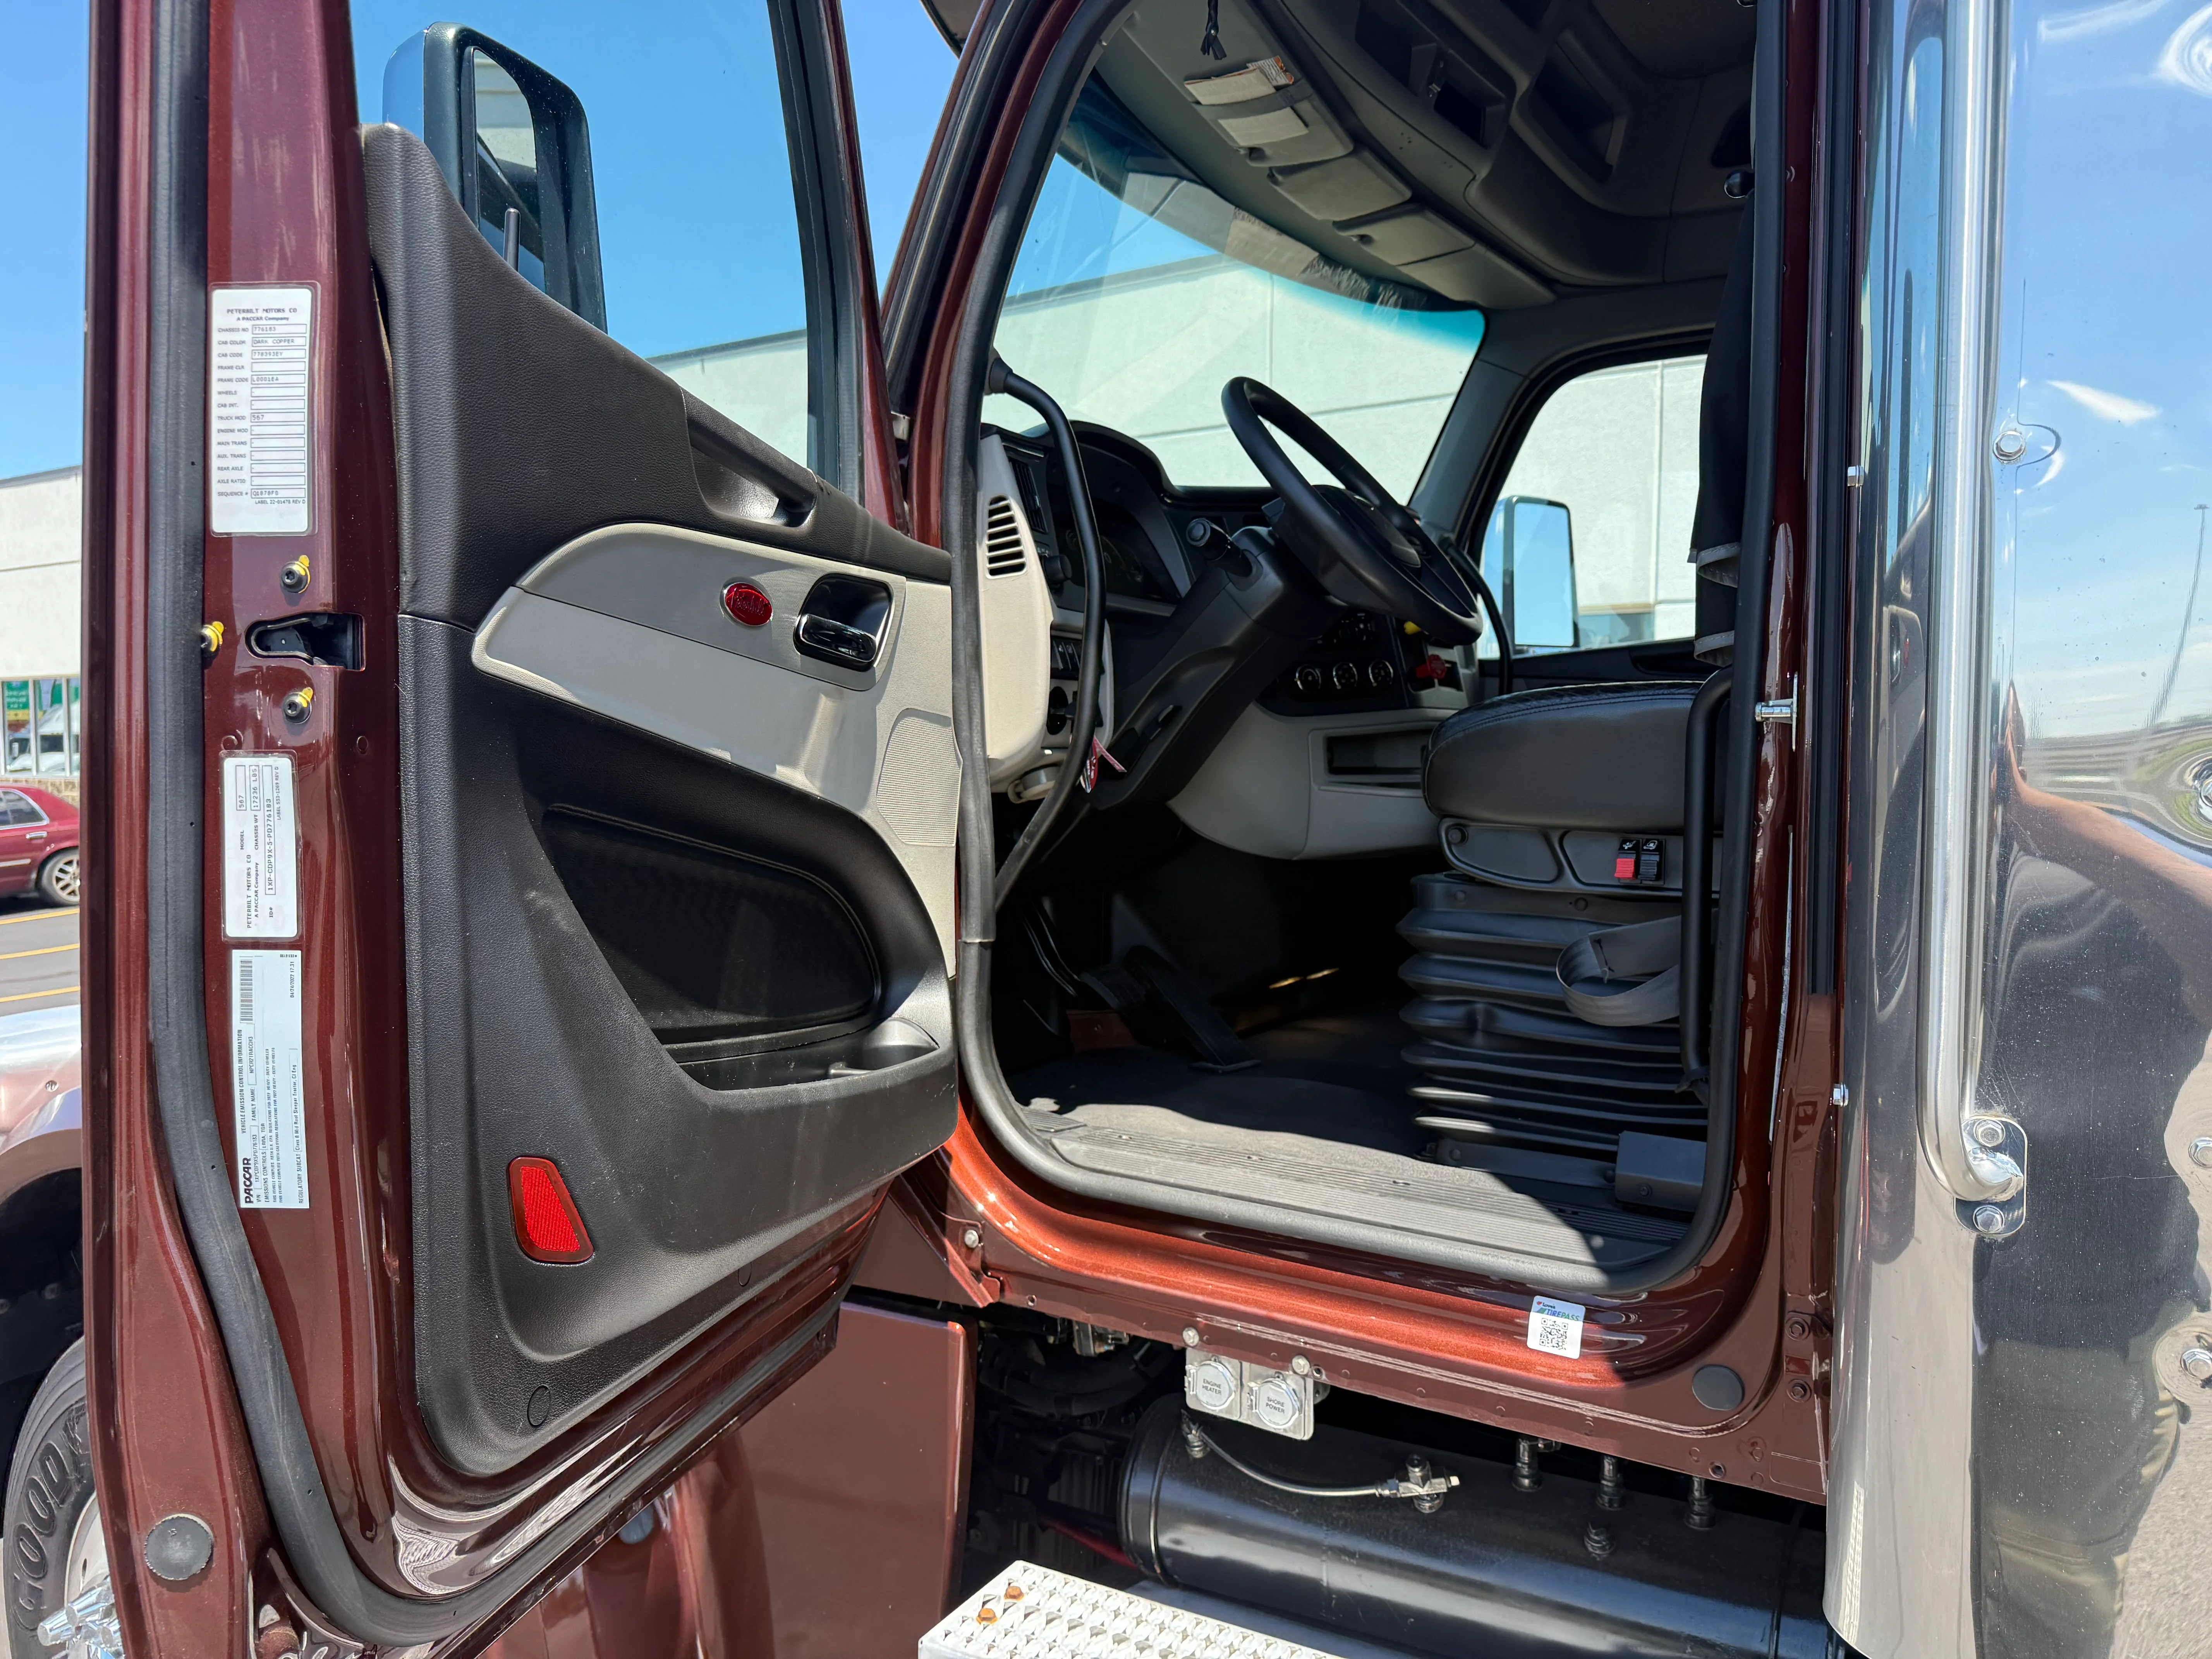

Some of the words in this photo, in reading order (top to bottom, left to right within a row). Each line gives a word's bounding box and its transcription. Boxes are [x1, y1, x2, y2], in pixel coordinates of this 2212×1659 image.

[254, 814, 258, 823] WT
[246, 855, 251, 863] CO
[242, 1158, 254, 1204] PACCAR
[1547, 1309, 1580, 1321] TIREPASS
[1203, 1378, 1221, 1389] ENGINE
[1202, 1385, 1222, 1395] HEATER
[1267, 1396, 1285, 1407] SHORE
[1266, 1402, 1285, 1413] POWER
